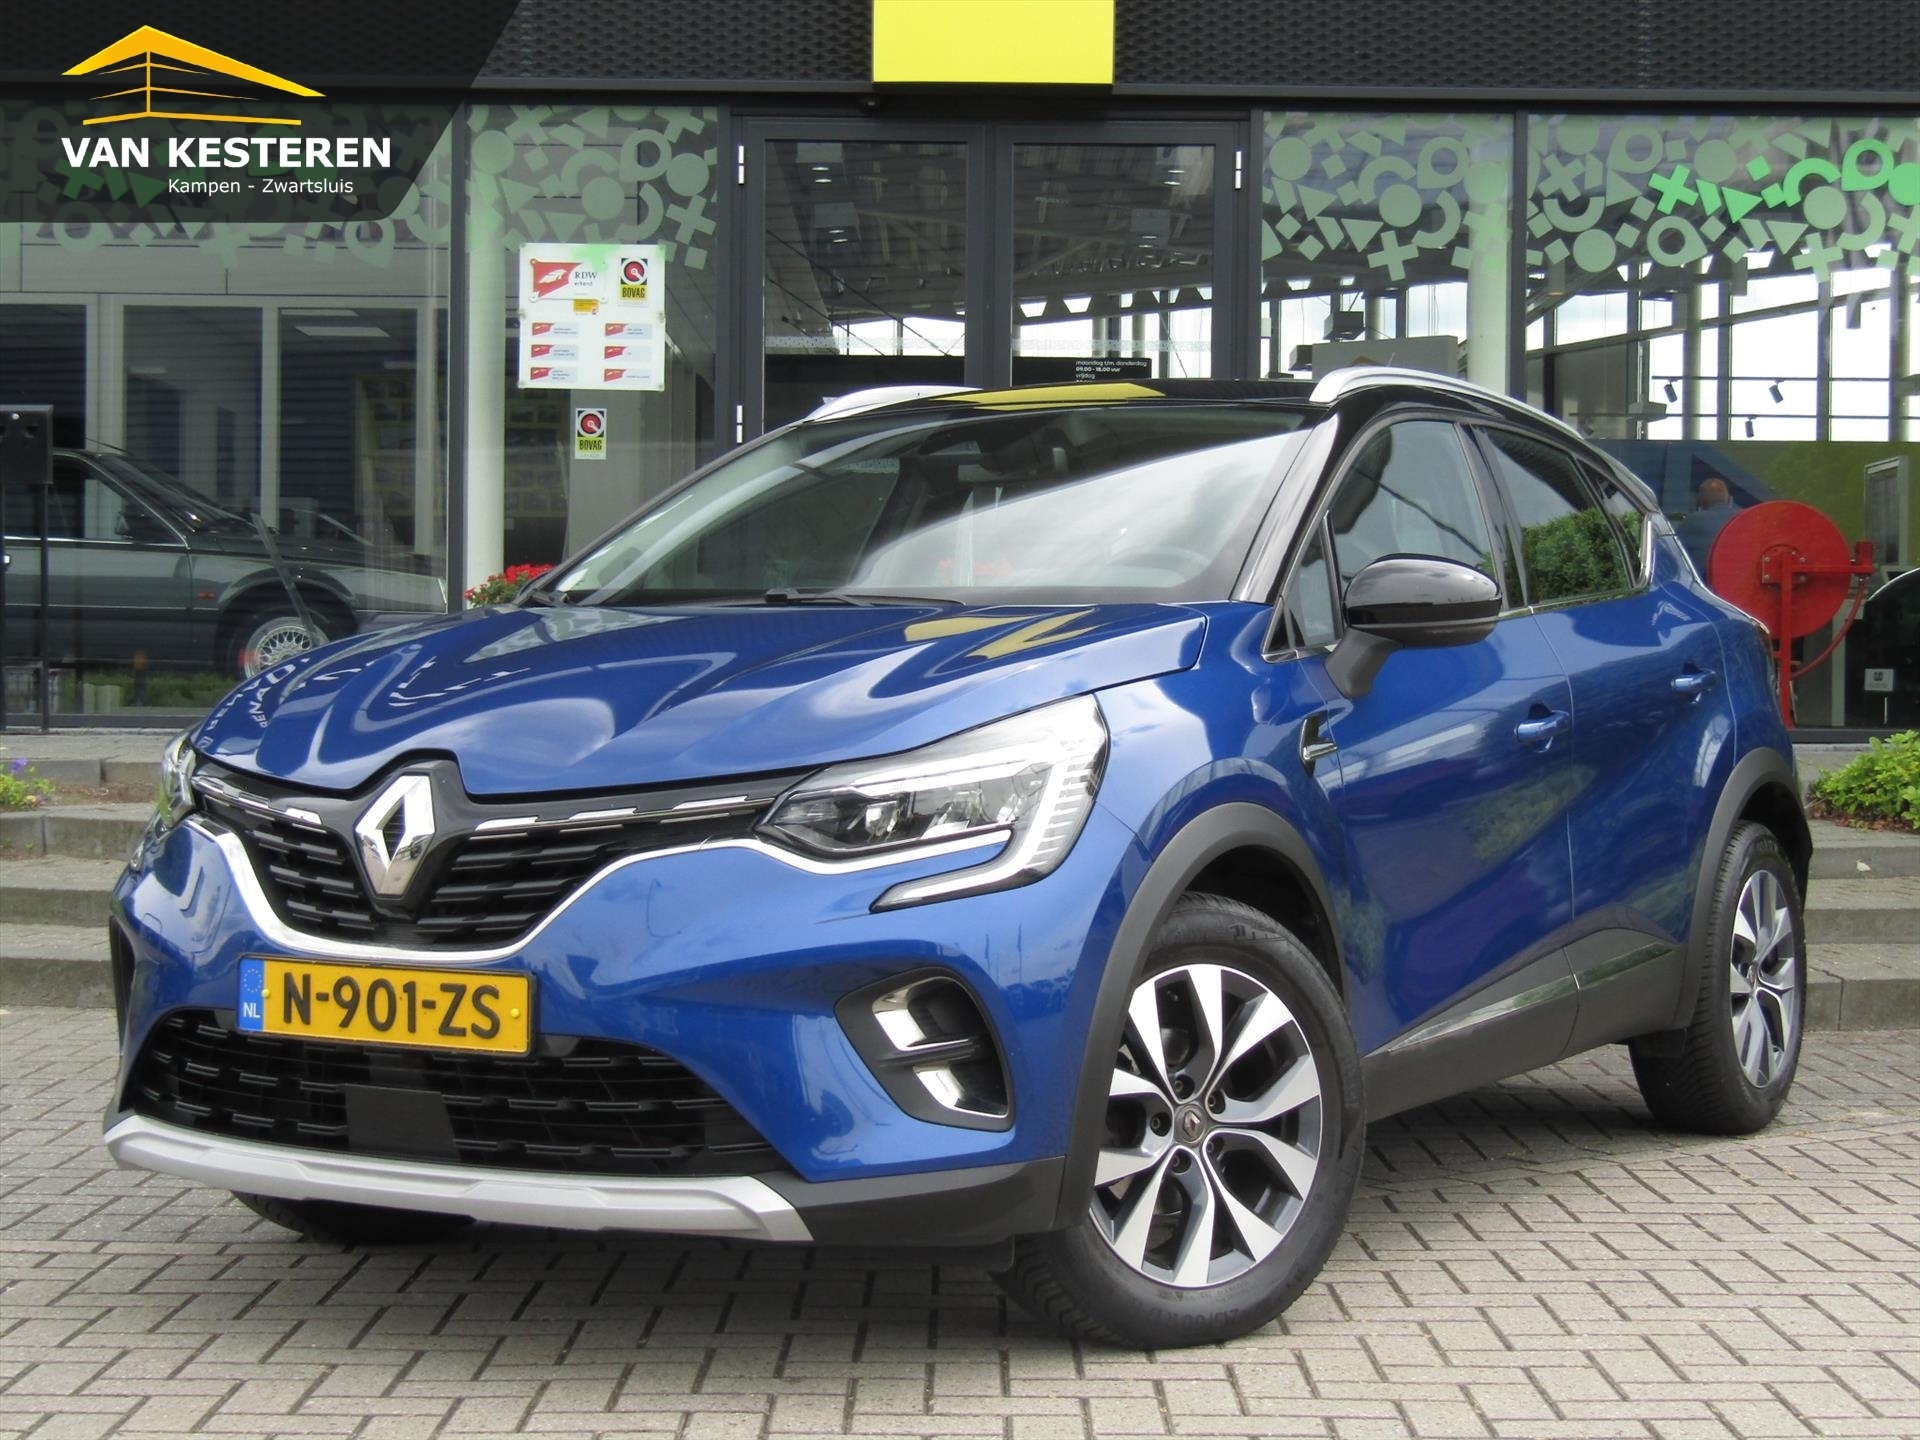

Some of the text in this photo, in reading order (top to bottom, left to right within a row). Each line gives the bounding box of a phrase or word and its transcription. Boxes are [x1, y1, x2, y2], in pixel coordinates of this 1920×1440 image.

[574, 271, 598, 279] RDW
[622, 287, 646, 298] BOVAG
[579, 439, 602, 450] BOVAG
[243, 1001, 261, 1019] NL
[283, 971, 501, 1040] N-901-ZS
